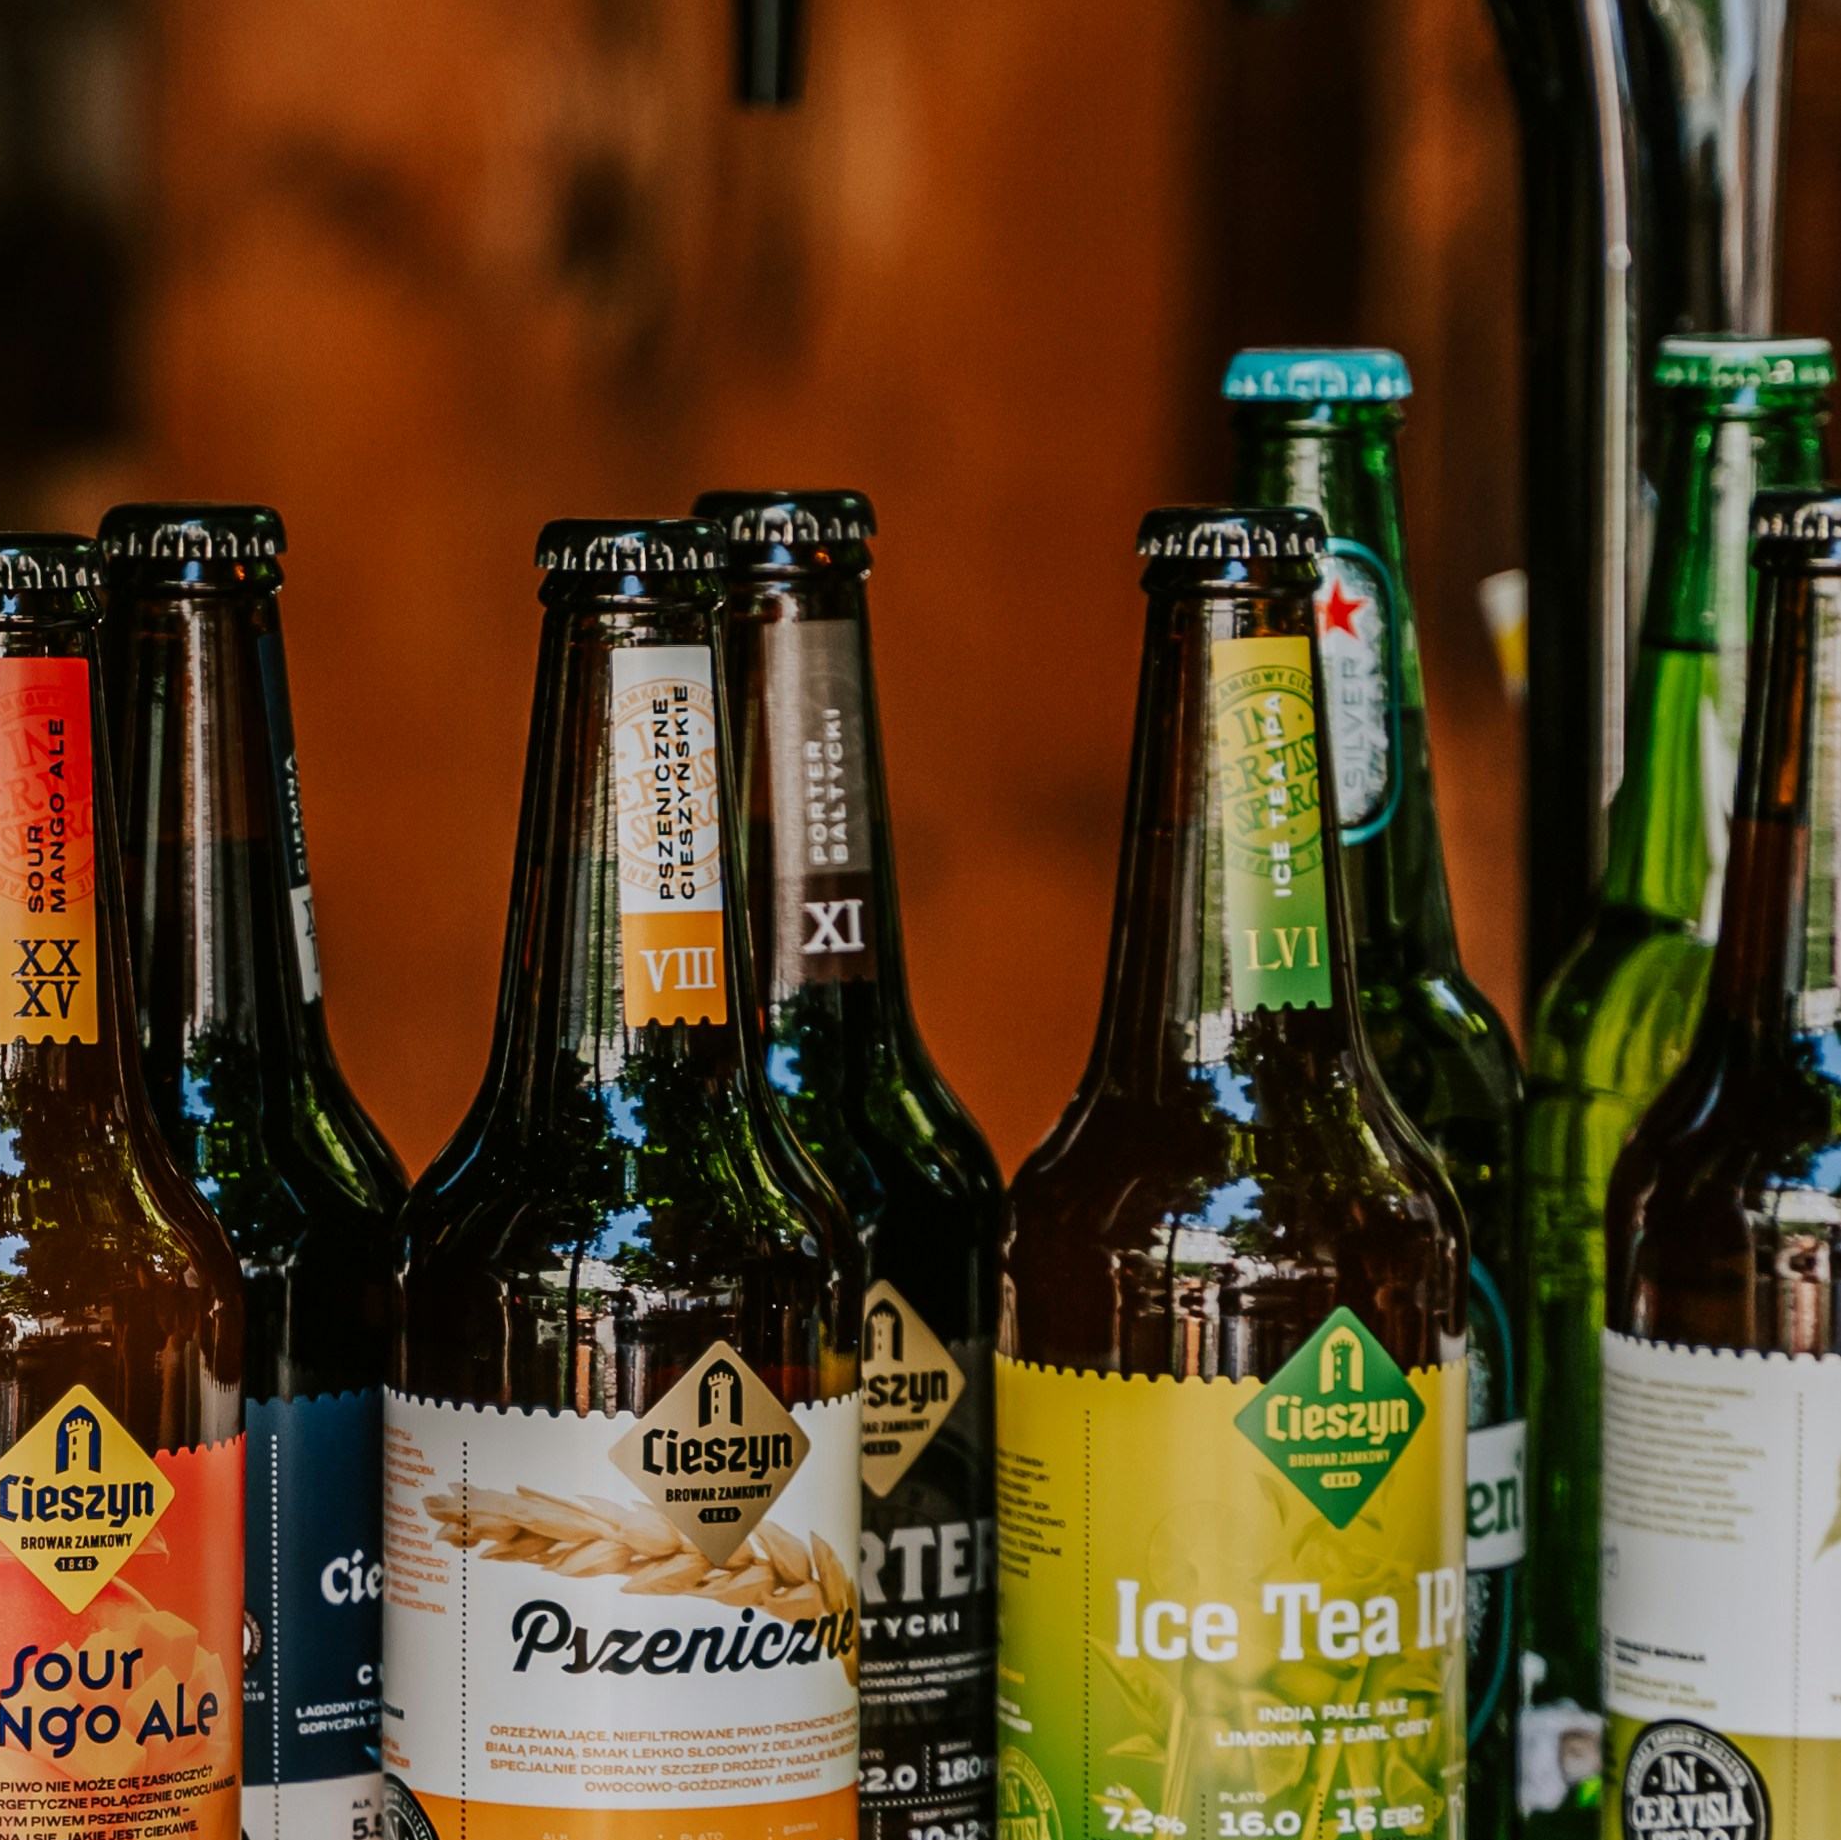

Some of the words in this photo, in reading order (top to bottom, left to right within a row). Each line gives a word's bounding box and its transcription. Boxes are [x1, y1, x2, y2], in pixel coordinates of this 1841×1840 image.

[1264, 693, 1284, 749] IPA
[49, 718, 65, 780] ALE
[653, 698, 674, 900] PSZENICZNE
[674, 685, 696, 900] CIESZYŃSKIE
[807, 740, 827, 865] PORTER
[1267, 761, 1288, 828] TEA
[28, 825, 44, 913] SOUR
[49, 793, 66, 913] MANGO
[1272, 841, 1292, 897] ICE
[803, 899, 865, 954] XI
[14, 939, 81, 976] XX
[1243, 926, 1320, 970] LVI
[640, 947, 717, 993] VIII
[13, 980, 79, 1018] XV
[862, 1369, 949, 1414] szyn
[881, 1418, 930, 1434] ZAMKOWY
[1265, 1394, 1410, 1445] Cieszyn
[642, 1428, 793, 1479] Cieszyn
[1289, 1452, 1337, 1468] BROWAR
[1339, 1449, 1390, 1465] ZAMKOWY
[665, 1487, 715, 1502] BROWAR
[717, 1484, 773, 1501] ZAMKOWY
[21, 1535, 72, 1550] BROWAR
[75, 1533, 132, 1548] ZAMKOWY
[60, 1557, 93, 1571] 1846
[512, 1599, 855, 1675] Pszeniczne
[1116, 1579, 1239, 1663] Ice
[1263, 1582, 1401, 1662] Tea
[298, 1717, 366, 1735] GORYCZKA
[1258, 1706, 1316, 1722] INDIA
[1321, 1702, 1370, 1720] PALE
[1376, 1698, 1409, 1716] ALE
[613, 1728, 734, 1743] NIEFILTROWANE
[737, 1725, 772, 1738] PIWO
[775, 1715, 835, 1735] PSZENICZNE
[1215, 1730, 1316, 1747] LIMONKA
[1322, 1728, 1337, 1745] Z
[1342, 1725, 1390, 1743] EARL
[1394, 1718, 1434, 1738] GREY
[485, 1741, 527, 1758] BIAŁĄ
[582, 1748, 628, 1759] SMAK
[632, 1747, 684, 1760] LEKKO
[687, 1743, 758, 1758] SŁODOWY
[490, 1758, 577, 1776] SPECJALNIE
[580, 1764, 657, 1776] DOBRANY
[661, 1763, 720, 1776] SZCZEP
[722, 1756, 783, 1773] DROŻDŻY
[786, 1751, 826, 1767] NADAJE
[1, 1780, 43, 1793] PIWO
[45, 1780, 70, 1793] NIE
[73, 1776, 116, 1793] MOŻE
[118, 1776, 141, 1791] CIĘ
[142, 1764, 213, 1787] ZASKOCZYĆ?
[1660, 1755, 1697, 1793] IN
[91, 1789, 172, 1808] POŁĄCZENIE
[174, 1781, 212, 1800] OWOCU
[1218, 1792, 1268, 1804] PLATO
[31, 1815, 85, 1827] PIWEM
[88, 1806, 181, 1826] PSZENICZNYM
[1102, 1805, 1188, 1836] 7.2%
[1218, 1810, 1302, 1837] 16.0
[1336, 1806, 1378, 1833] 16
[1381, 1805, 1425, 1829] EBC
